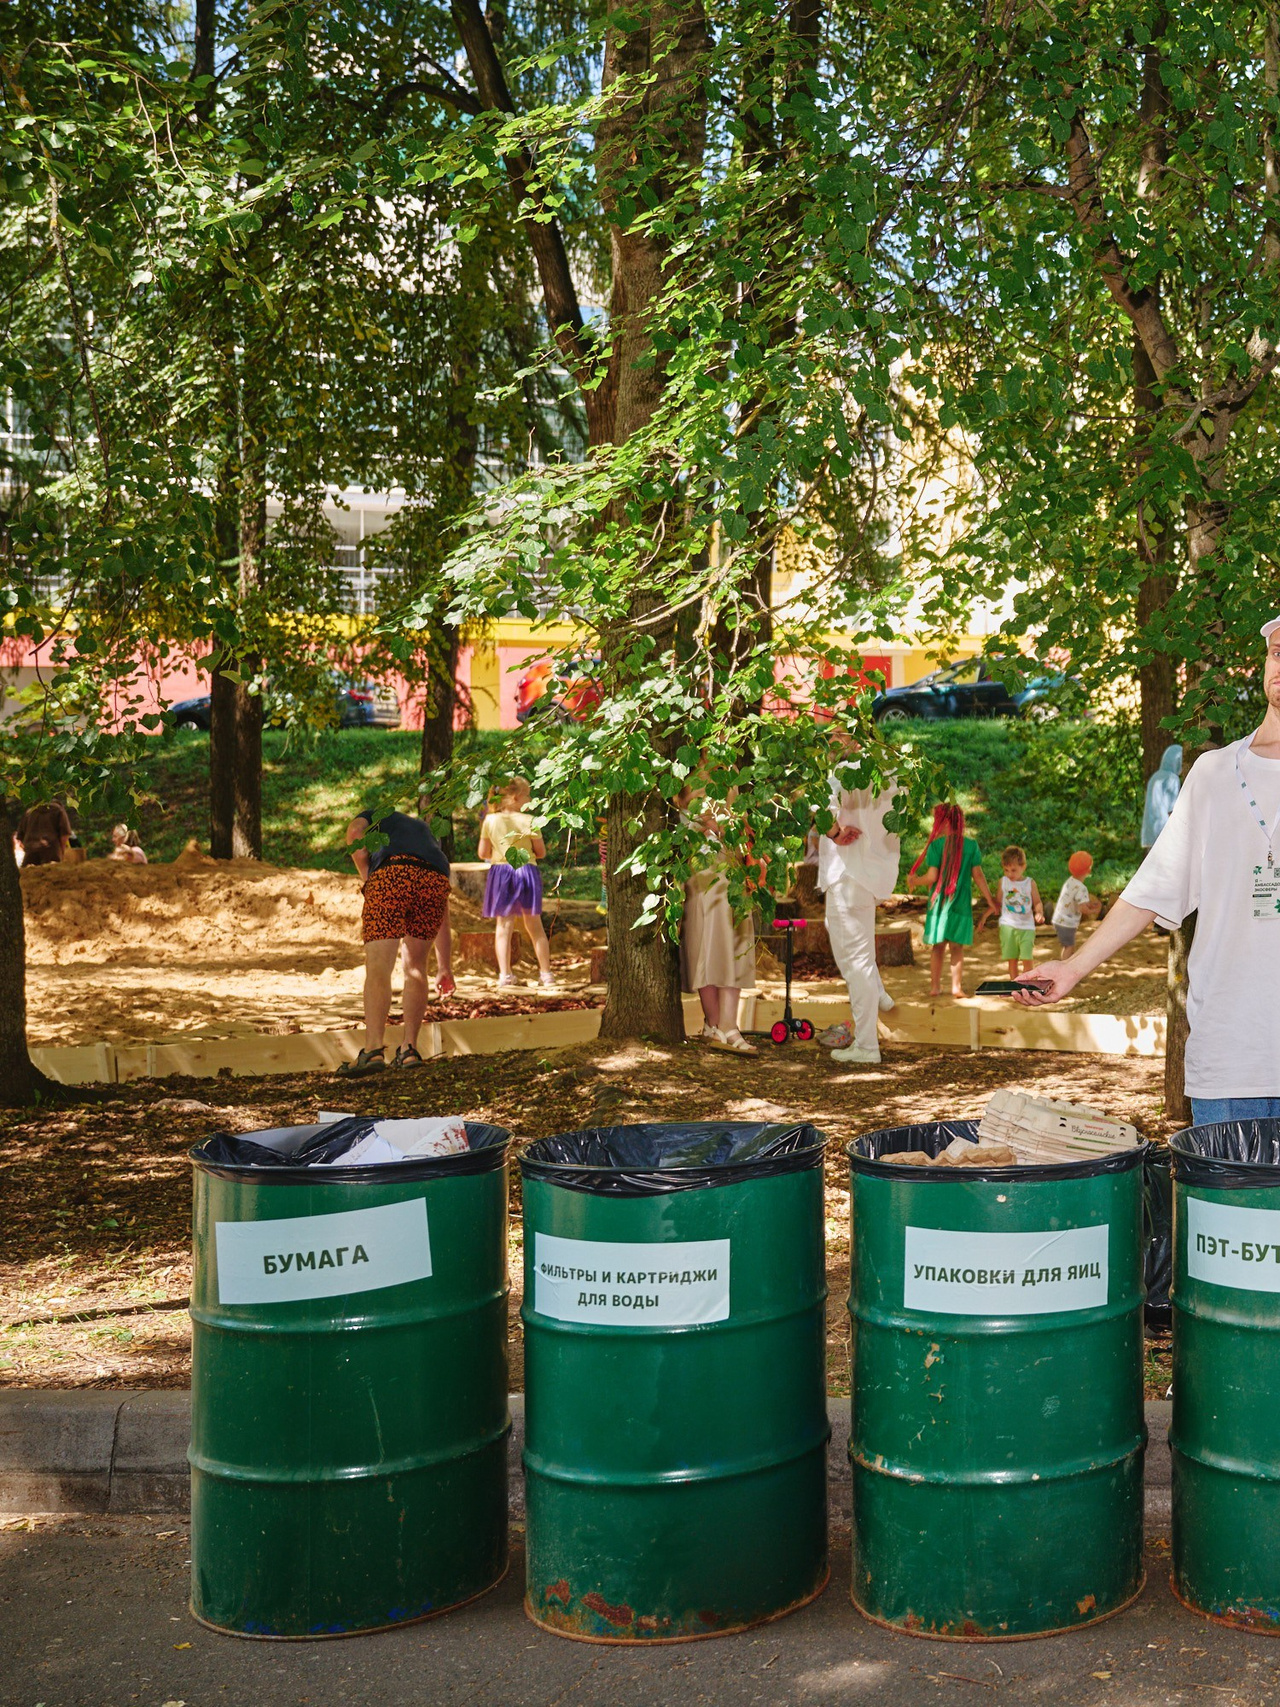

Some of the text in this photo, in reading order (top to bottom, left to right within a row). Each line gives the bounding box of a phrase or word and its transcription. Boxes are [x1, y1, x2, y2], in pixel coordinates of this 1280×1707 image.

[263, 1244, 370, 1275] БУМАГА
[541, 1261, 718, 1287] ФИЛЬТРЫ И КАРТРИДЖИ
[913, 1261, 1102, 1287] УПАКОВКИ ДЛЯ ЯИЦ
[577, 1291, 660, 1309] ДЛЯ ВОДЫ
